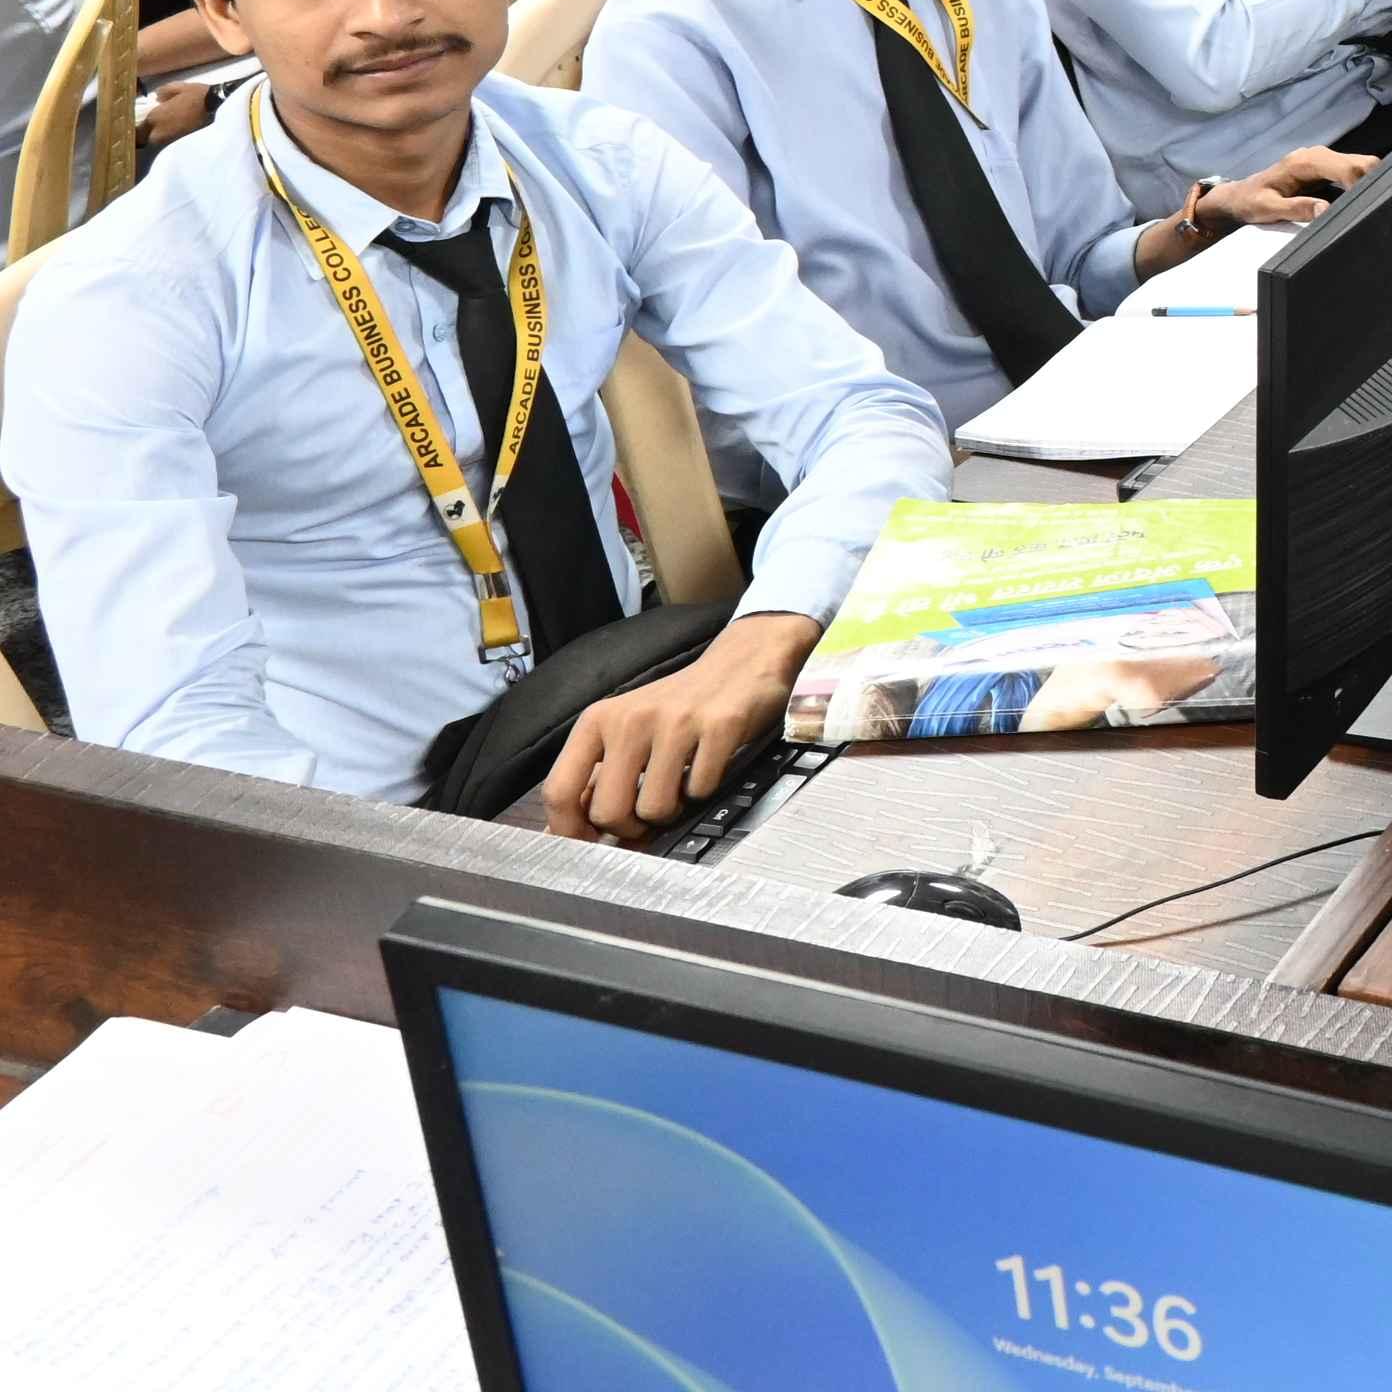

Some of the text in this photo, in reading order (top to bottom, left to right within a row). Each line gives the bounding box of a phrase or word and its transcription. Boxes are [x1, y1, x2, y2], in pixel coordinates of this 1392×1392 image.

[876, 0, 936, 61] BUSINESS
[341, 286, 404, 389] BUSINESS
[519, 273, 545, 361] BUSINESS
[389, 388, 444, 469] ARCADE
[507, 366, 537, 456] ARCADE
[995, 1255, 1203, 1362] 11:36
[993, 1336, 1099, 1380] Wednesday,
